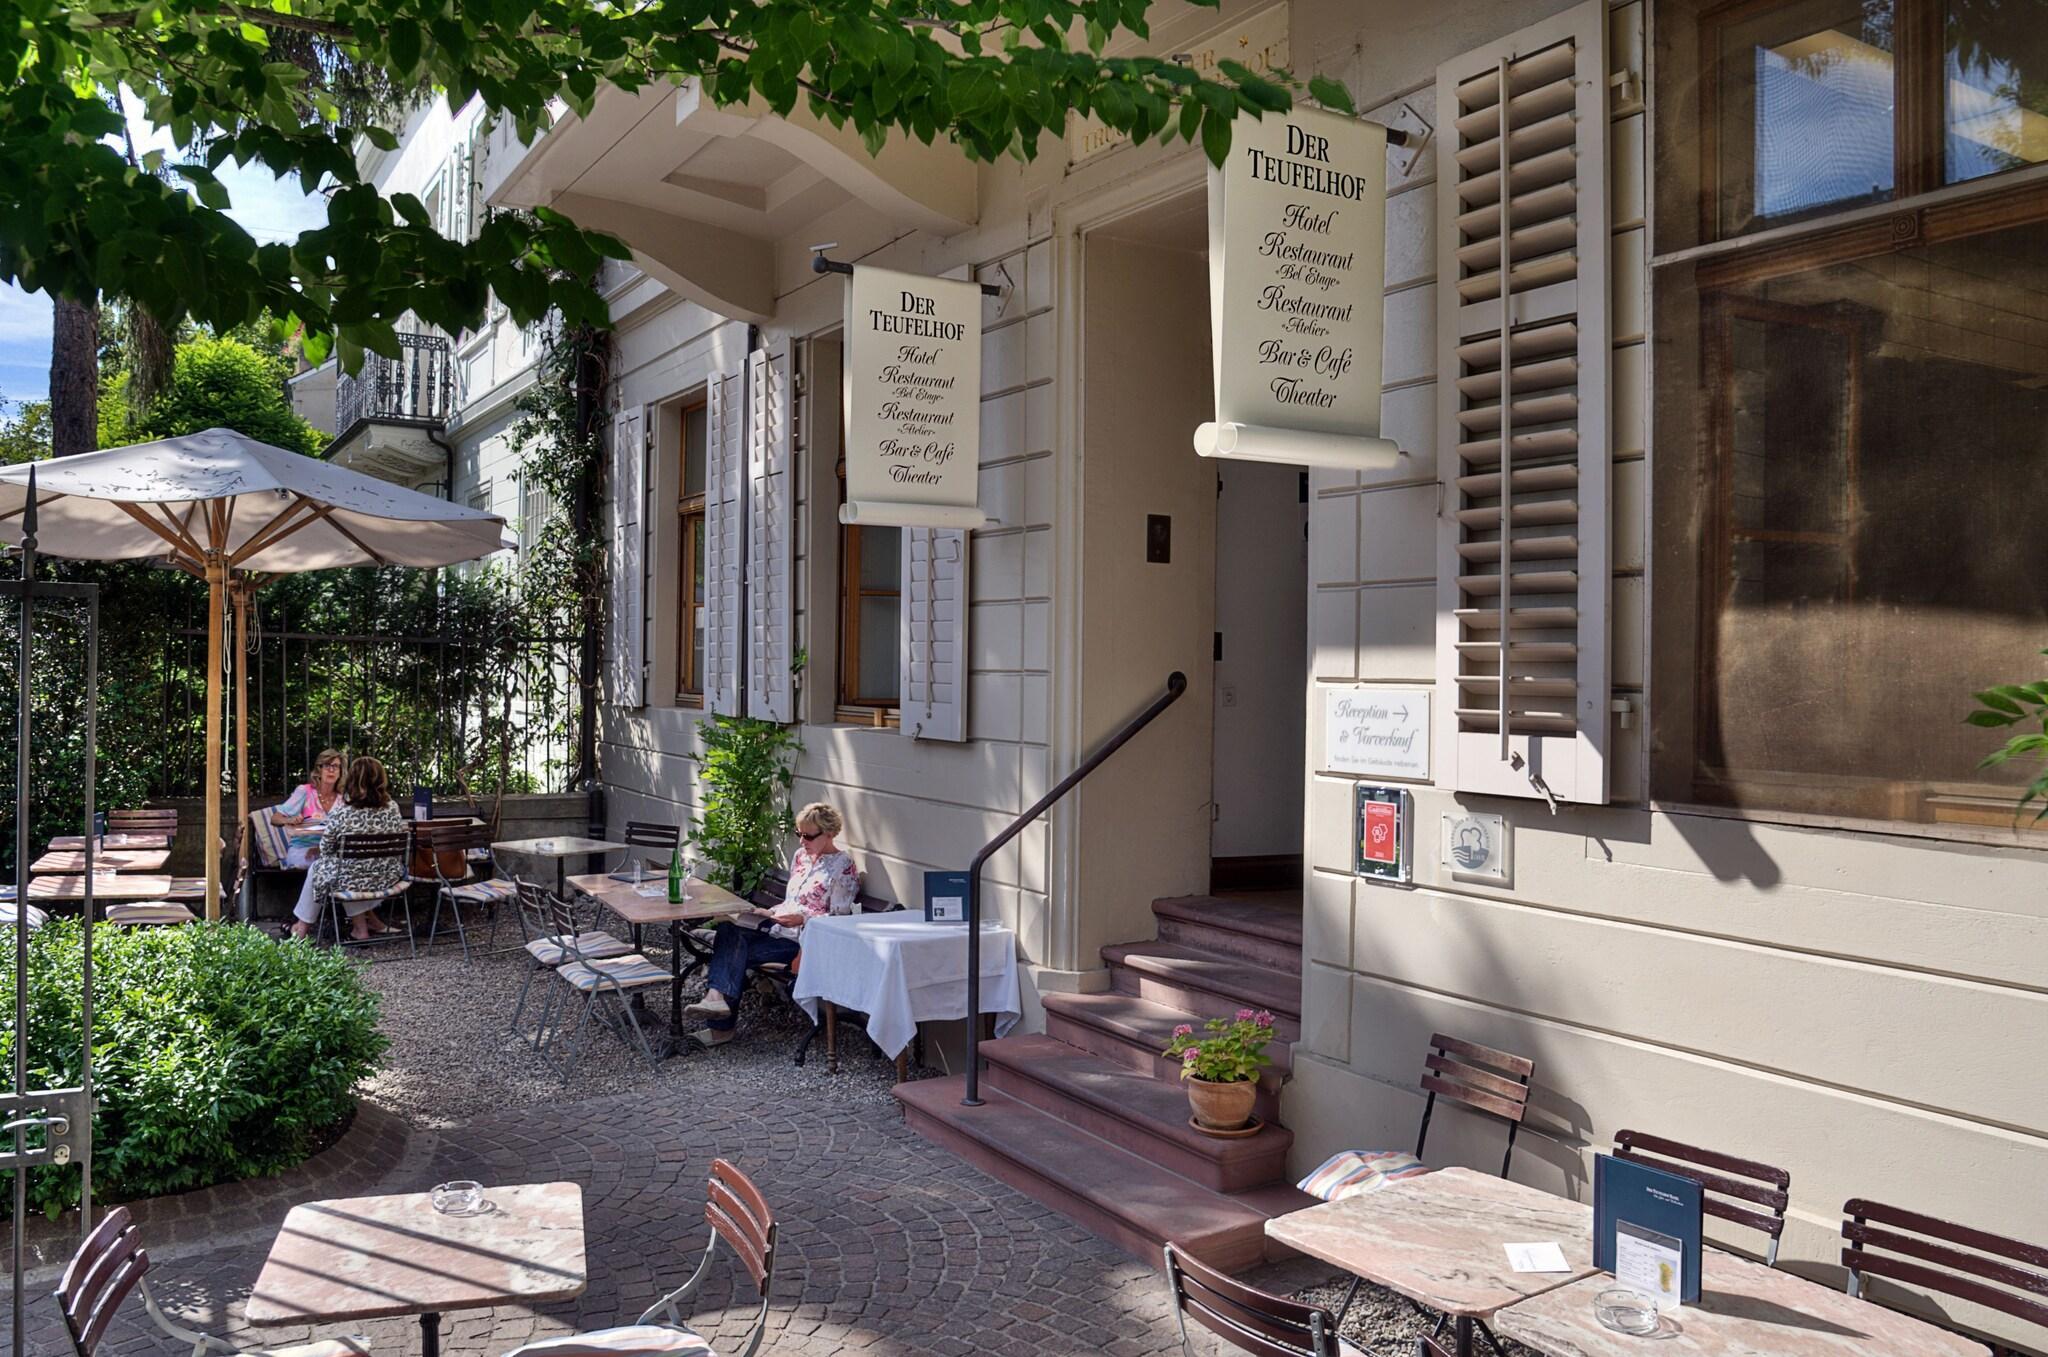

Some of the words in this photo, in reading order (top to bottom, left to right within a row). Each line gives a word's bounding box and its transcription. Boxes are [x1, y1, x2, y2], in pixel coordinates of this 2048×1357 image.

[1285, 124, 1331, 164] DER
[1247, 147, 1366, 202] TEUFELHOF
[1282, 204, 1339, 235] Hotel
[1258, 231, 1355, 271] Restaurant
[900, 291, 936, 317] DER
[1256, 285, 1354, 323] Restaurant
[869, 309, 966, 341] TEUFELHOF
[897, 345, 943, 366] Hotel
[1258, 339, 1297, 367] Bar
[1297, 348, 1313, 369] &
[1314, 345, 1353, 381] Café
[878, 365, 955, 389] Restaurant
[1270, 376, 1337, 408] Theater
[877, 401, 955, 425] Restaurant
[879, 439, 910, 457] Bar
[910, 445, 922, 457] &
[923, 442, 955, 465] Café
[888, 464, 943, 486] Theater
[1334, 699, 1389, 725] Reception
[1352, 726, 1419, 754] Vorverkauf
